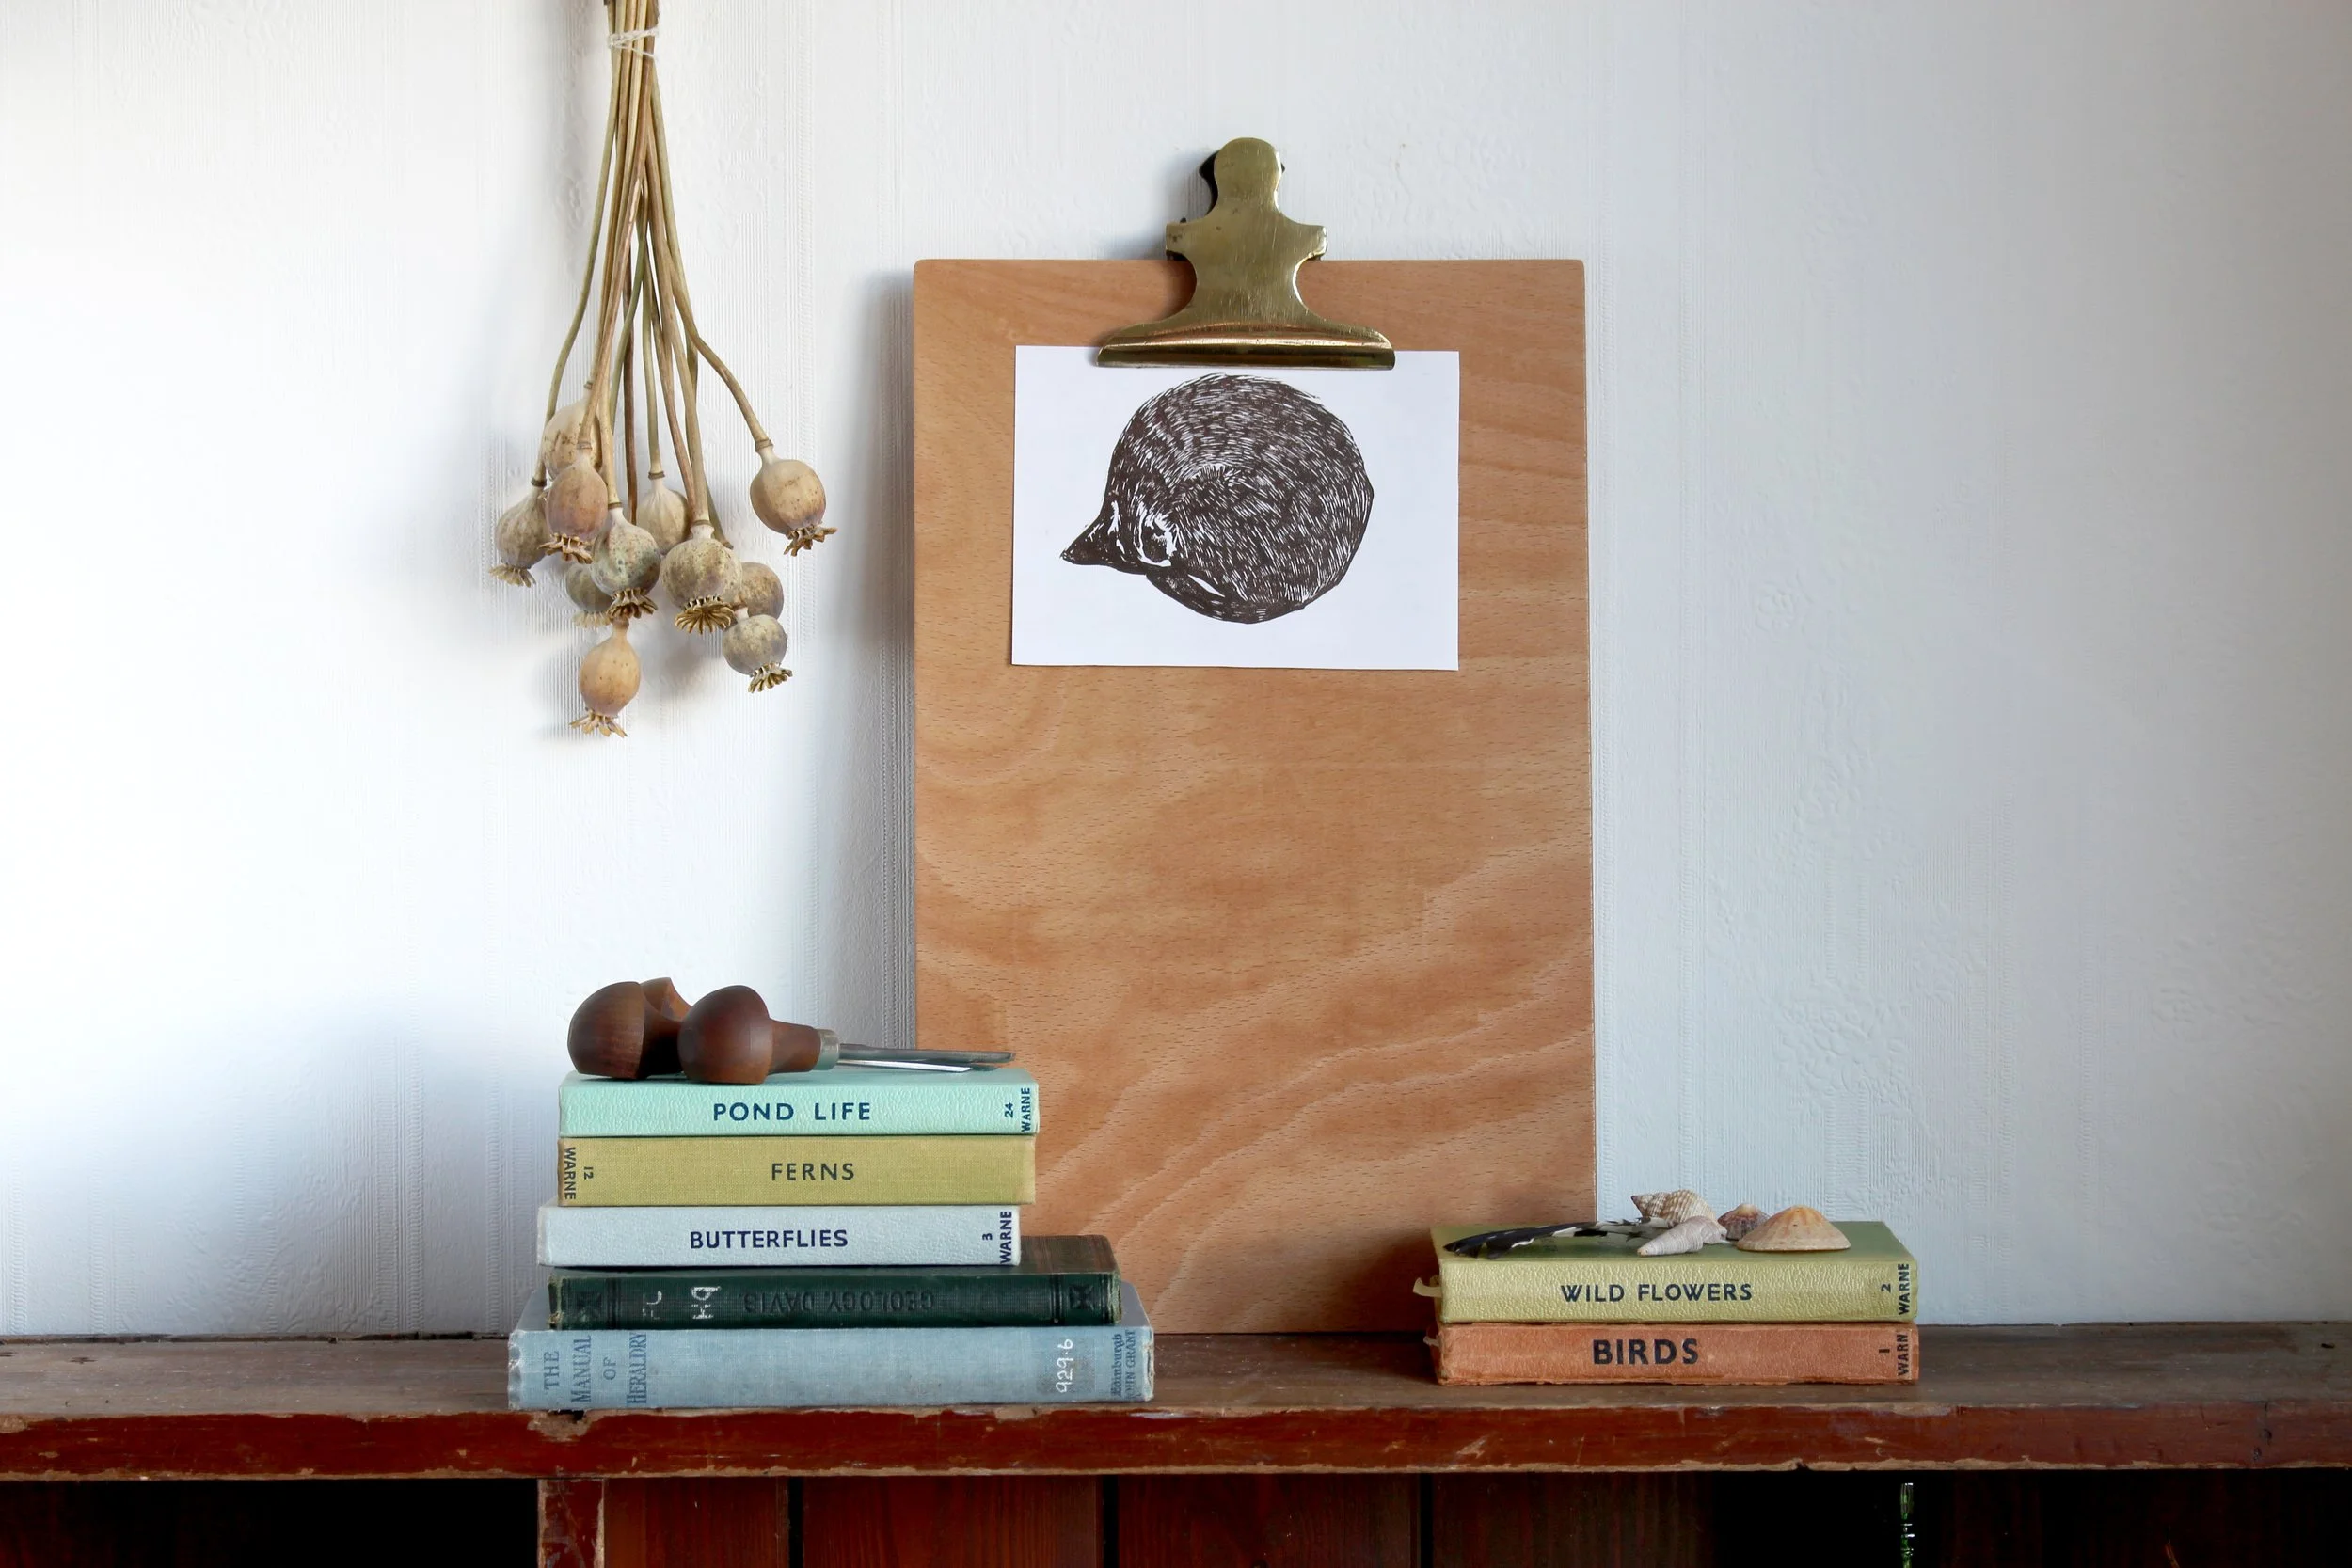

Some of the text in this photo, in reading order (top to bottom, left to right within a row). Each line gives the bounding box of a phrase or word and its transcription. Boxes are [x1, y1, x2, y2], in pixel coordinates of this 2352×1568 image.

[713, 1101, 871, 1121] POND LIFE
[1004, 1101, 1014, 1118] 24
[1020, 1087, 1031, 1132] WARNE
[564, 1147, 577, 1199] WARNE
[583, 1166, 594, 1180] 12
[771, 1162, 855, 1181] FERNS
[690, 1229, 849, 1249] BUTTERFLIES
[981, 1232, 993, 1241] 3
[999, 1211, 1012, 1265] WARNE
[1560, 1283, 1753, 1303] WILD FLOWERS
[1881, 1282, 1892, 1293] 2
[1897, 1263, 1910, 1316] WARNE
[1124, 1330, 1136, 1369] GRANT
[1592, 1338, 1700, 1365] BIRDS
[543, 1351, 560, 1390] THE
[571, 1334, 591, 1403] MANUAL
[603, 1356, 616, 1380] OF
[626, 1332, 646, 1404] HERALDRY
